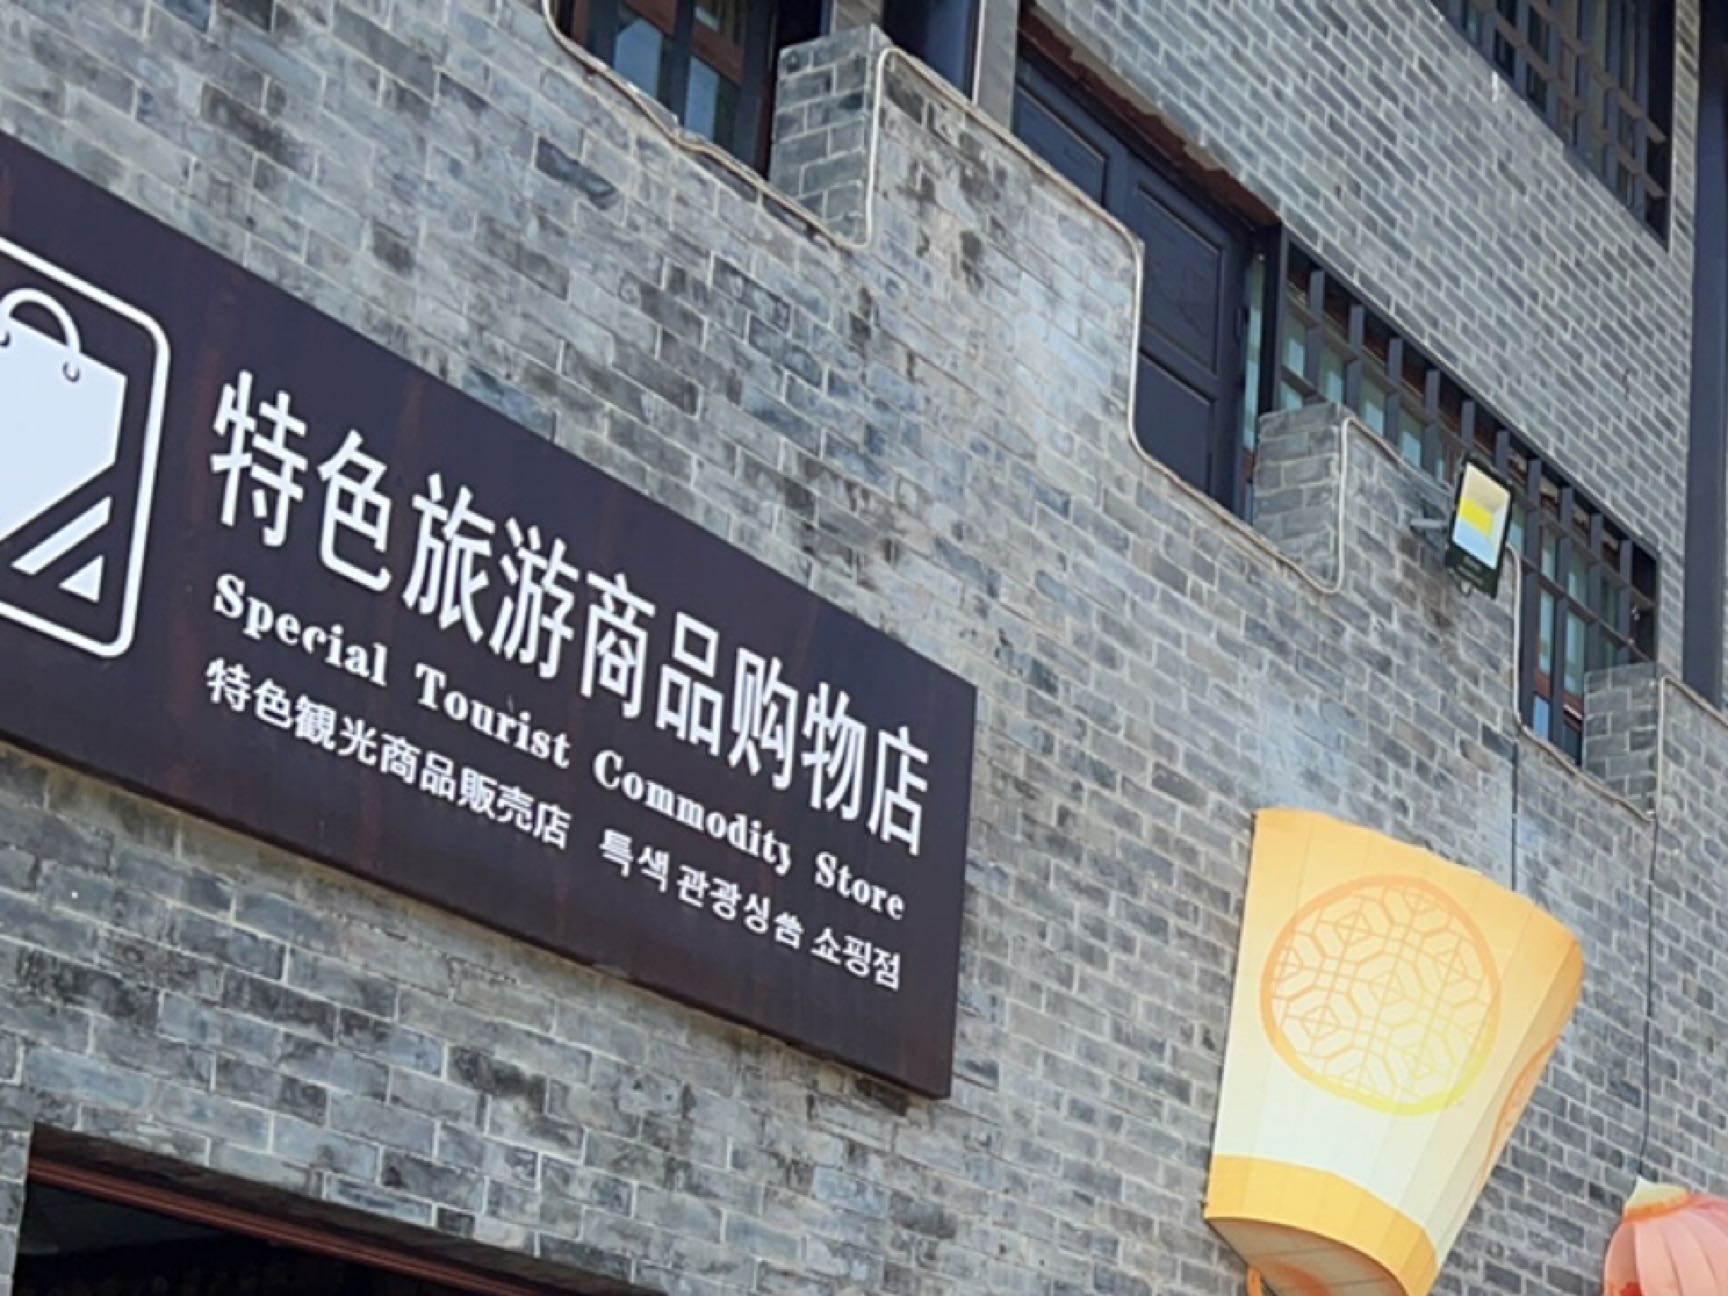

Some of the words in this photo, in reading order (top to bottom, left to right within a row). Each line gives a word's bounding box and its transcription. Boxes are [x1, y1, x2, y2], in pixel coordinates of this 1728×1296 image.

[210, 370, 930, 857] 特色旅游商品购物店
[213, 573, 388, 686] Special
[415, 662, 572, 769] Tourist
[593, 749, 793, 876] Commodity
[814, 850, 907, 920] Store
[205, 657, 573, 851] 特色観光商品販売店
[811, 927, 902, 992] 쇼핑점
